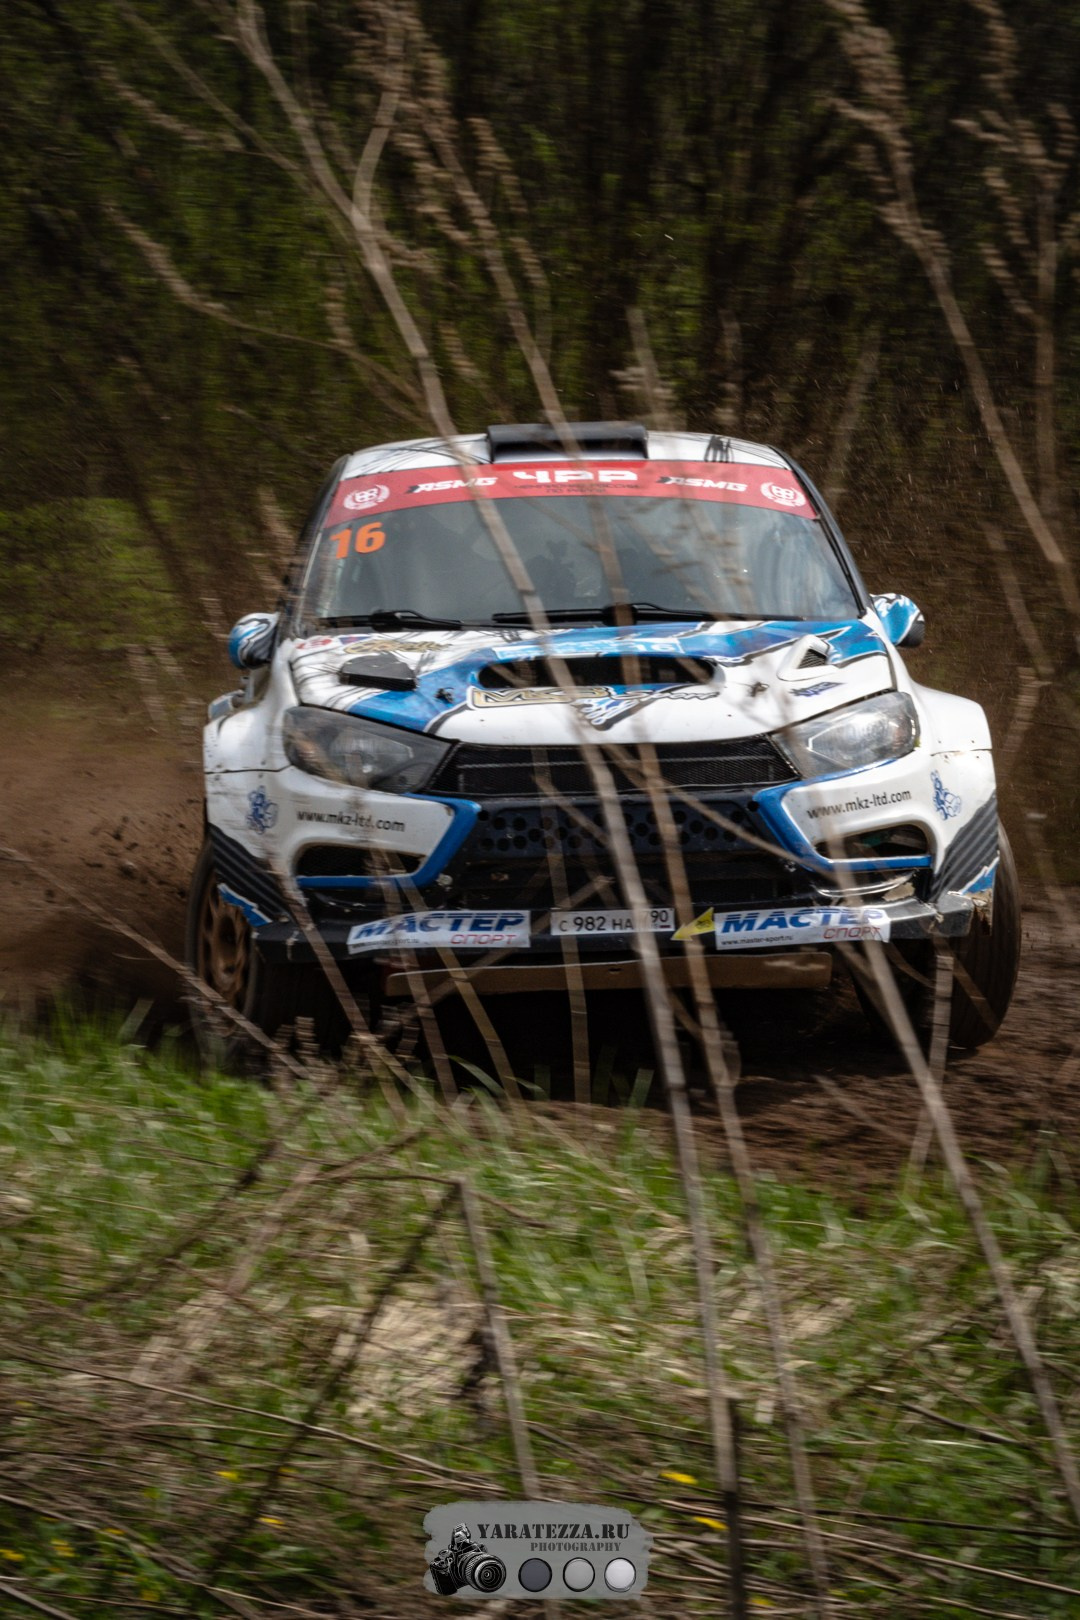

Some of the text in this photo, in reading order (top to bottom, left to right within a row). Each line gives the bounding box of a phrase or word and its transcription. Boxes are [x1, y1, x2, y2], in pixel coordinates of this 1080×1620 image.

[329, 521, 386, 560] 16
[806, 790, 912, 819] www.mkz-ltd.com
[296, 810, 406, 833] www.mkz-ltd.com
[353, 912, 526, 940] МАСТЕР
[573, 916, 606, 932] 982
[721, 908, 883, 934] МАСТЕР
[823, 926, 881, 940] СПОРТ
[450, 934, 517, 945] СПОРТ
